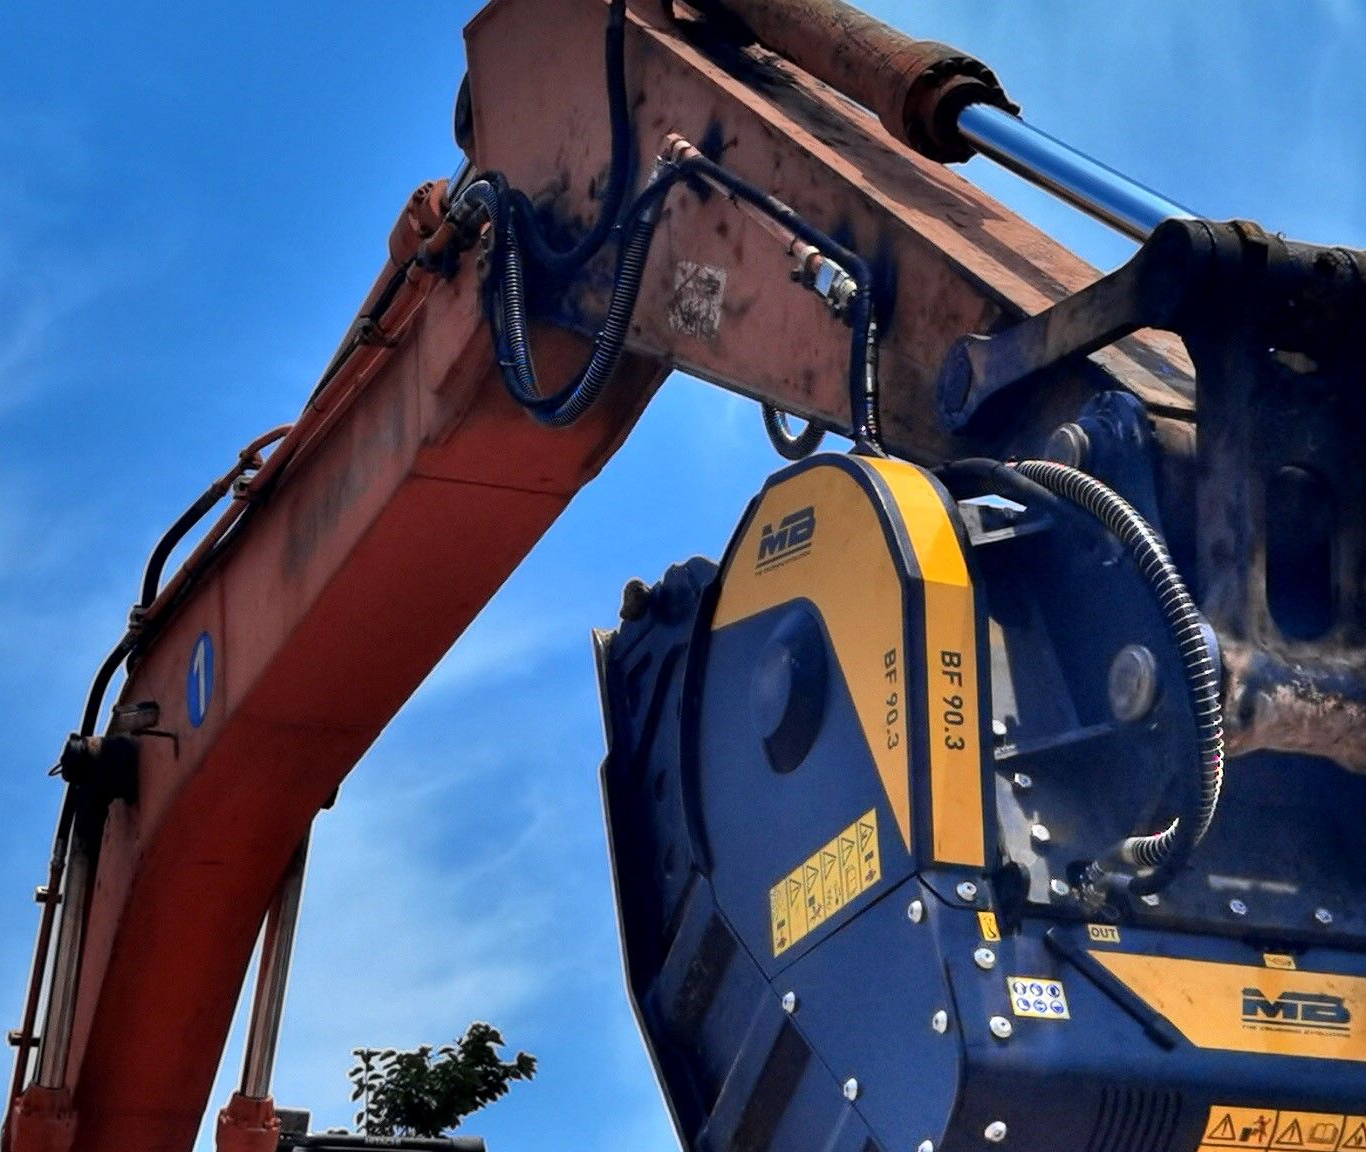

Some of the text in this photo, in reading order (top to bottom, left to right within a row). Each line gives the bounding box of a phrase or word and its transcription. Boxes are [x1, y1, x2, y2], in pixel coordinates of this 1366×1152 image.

[757, 505, 816, 561] MB
[884, 648, 900, 750] BF 90.3
[941, 650, 966, 751] BF 90.3
[1091, 926, 1116, 940] OUT
[1241, 987, 1351, 1024] MB
